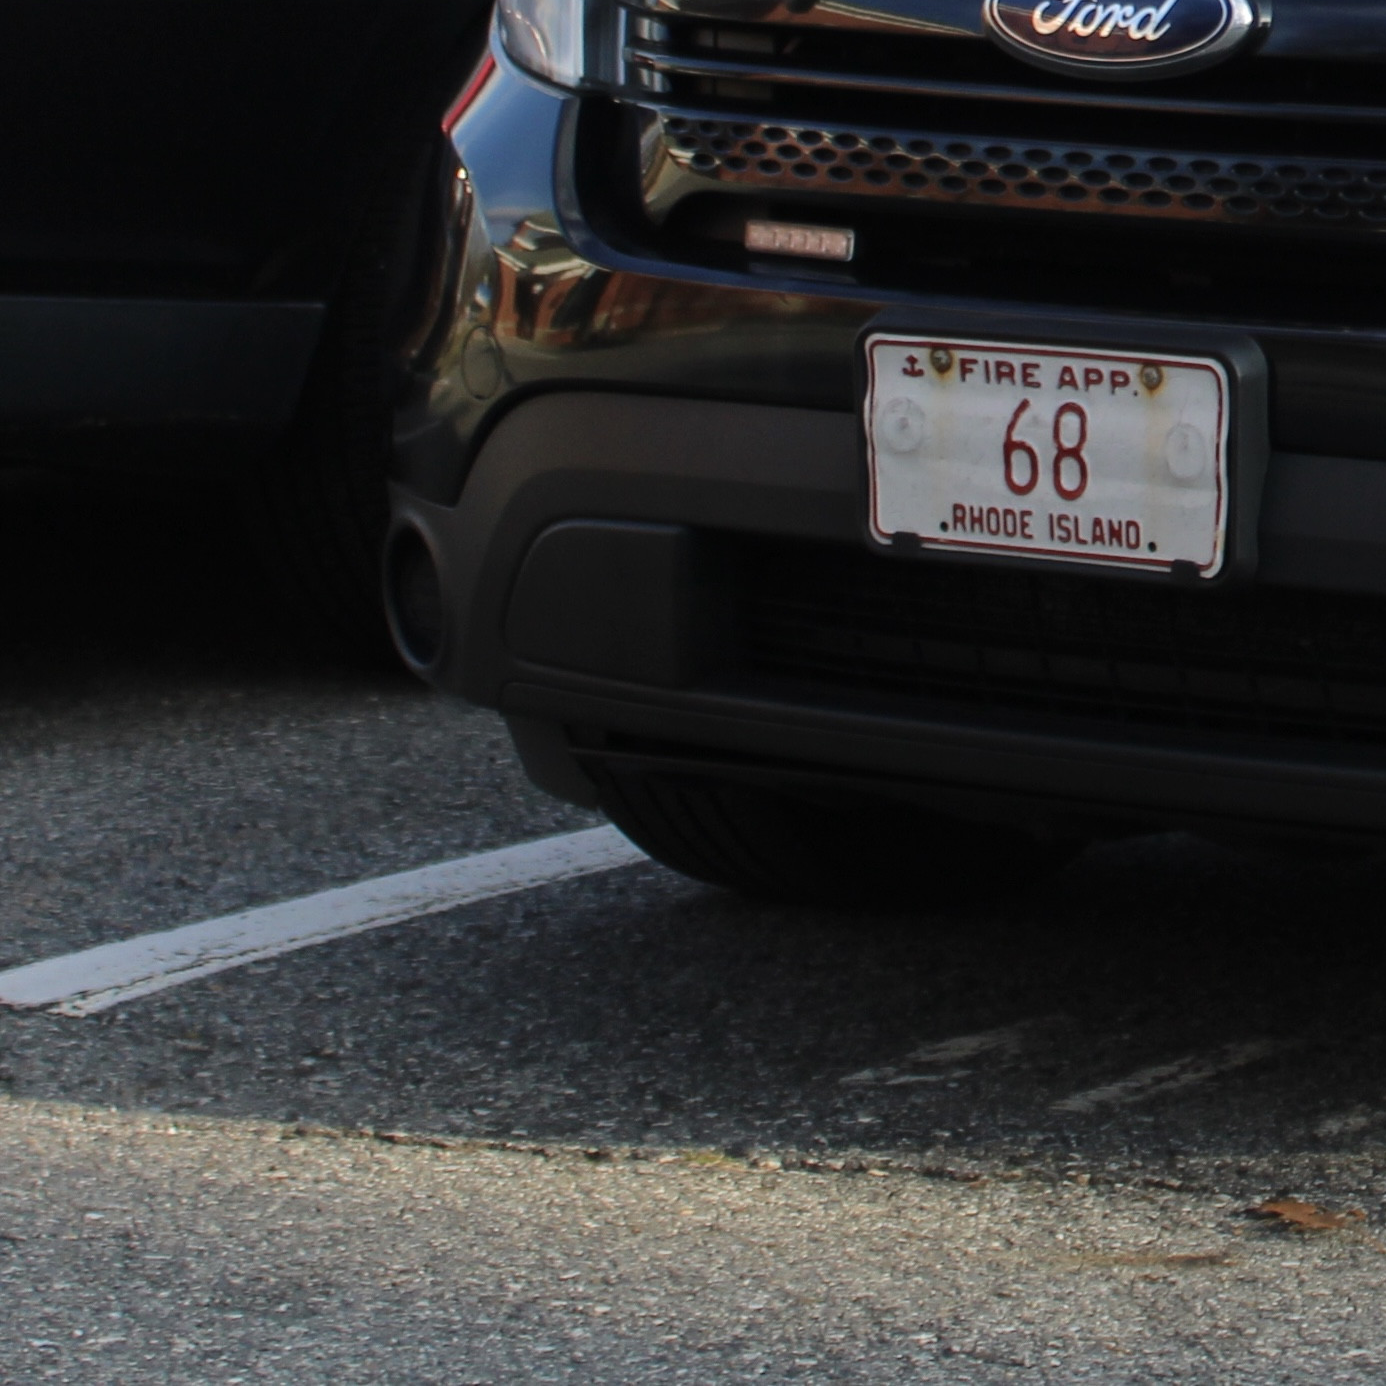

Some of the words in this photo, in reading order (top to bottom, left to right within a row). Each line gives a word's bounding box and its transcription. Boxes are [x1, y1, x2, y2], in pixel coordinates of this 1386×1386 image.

[958, 356, 1042, 389] FIRE
[1057, 365, 1140, 398] APP.
[1002, 397, 1089, 502] 68
[952, 502, 1034, 541] RHODE
[1048, 513, 1142, 552] ISLAND
